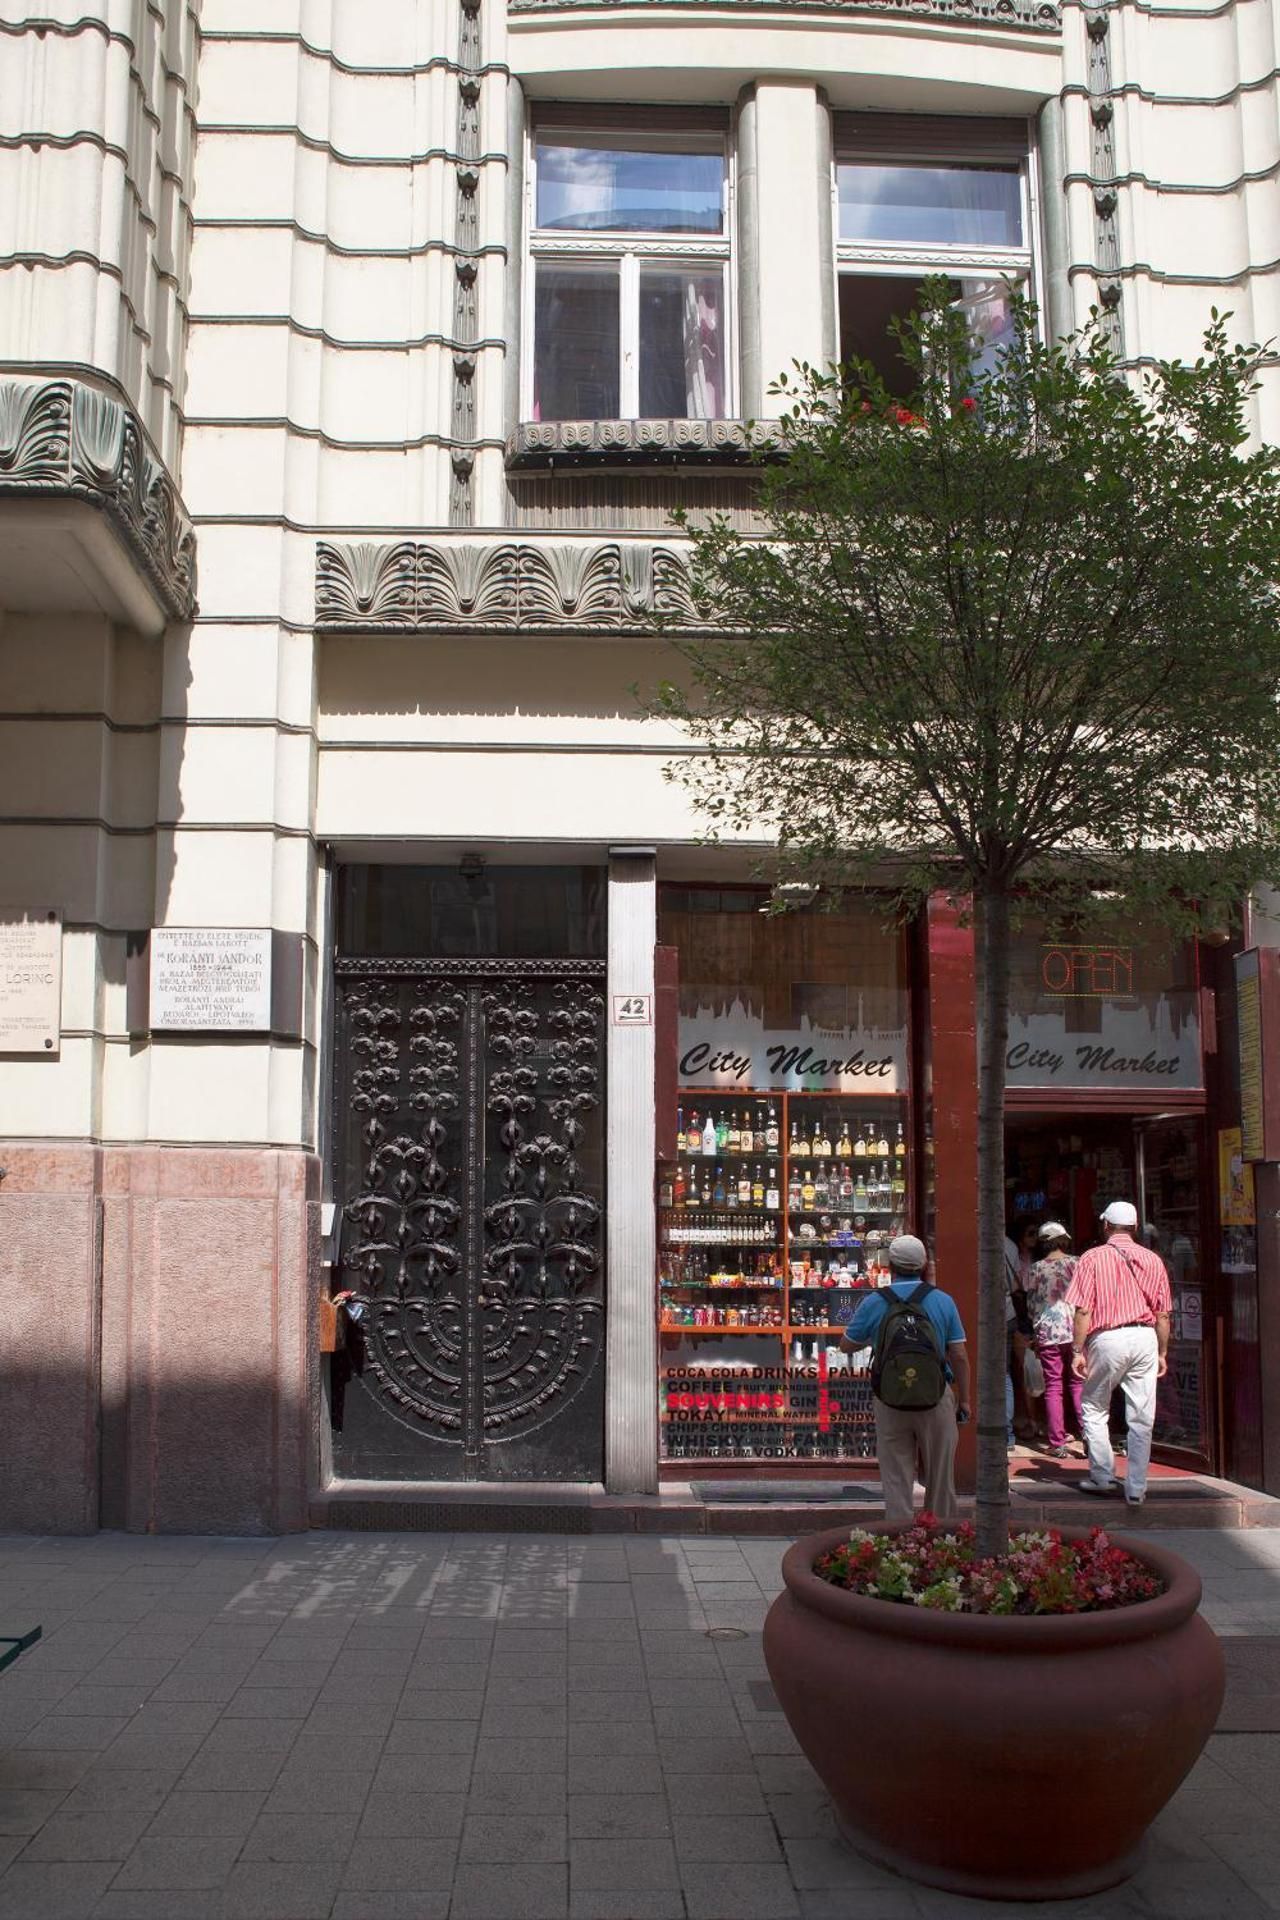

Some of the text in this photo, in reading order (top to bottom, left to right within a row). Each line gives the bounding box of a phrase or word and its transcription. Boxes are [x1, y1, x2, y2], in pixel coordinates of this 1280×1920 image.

[1043, 950, 1133, 992] OPEN
[620, 998, 645, 1014] 42
[679, 1043, 894, 1080] City Market
[1005, 1042, 1180, 1075] City Market
[667, 1366, 817, 1378] COCA COLA DRINKS
[667, 1381, 733, 1393] COFFEE
[667, 1393, 817, 1408] SOUVENIRS GIN
[668, 1410, 725, 1421] TOKAY
[667, 1423, 707, 1433] CHIPS
[712, 1423, 792, 1433] CHOCOLATE
[667, 1435, 744, 1447] WHISKY
[754, 1447, 804, 1457] VODKA
